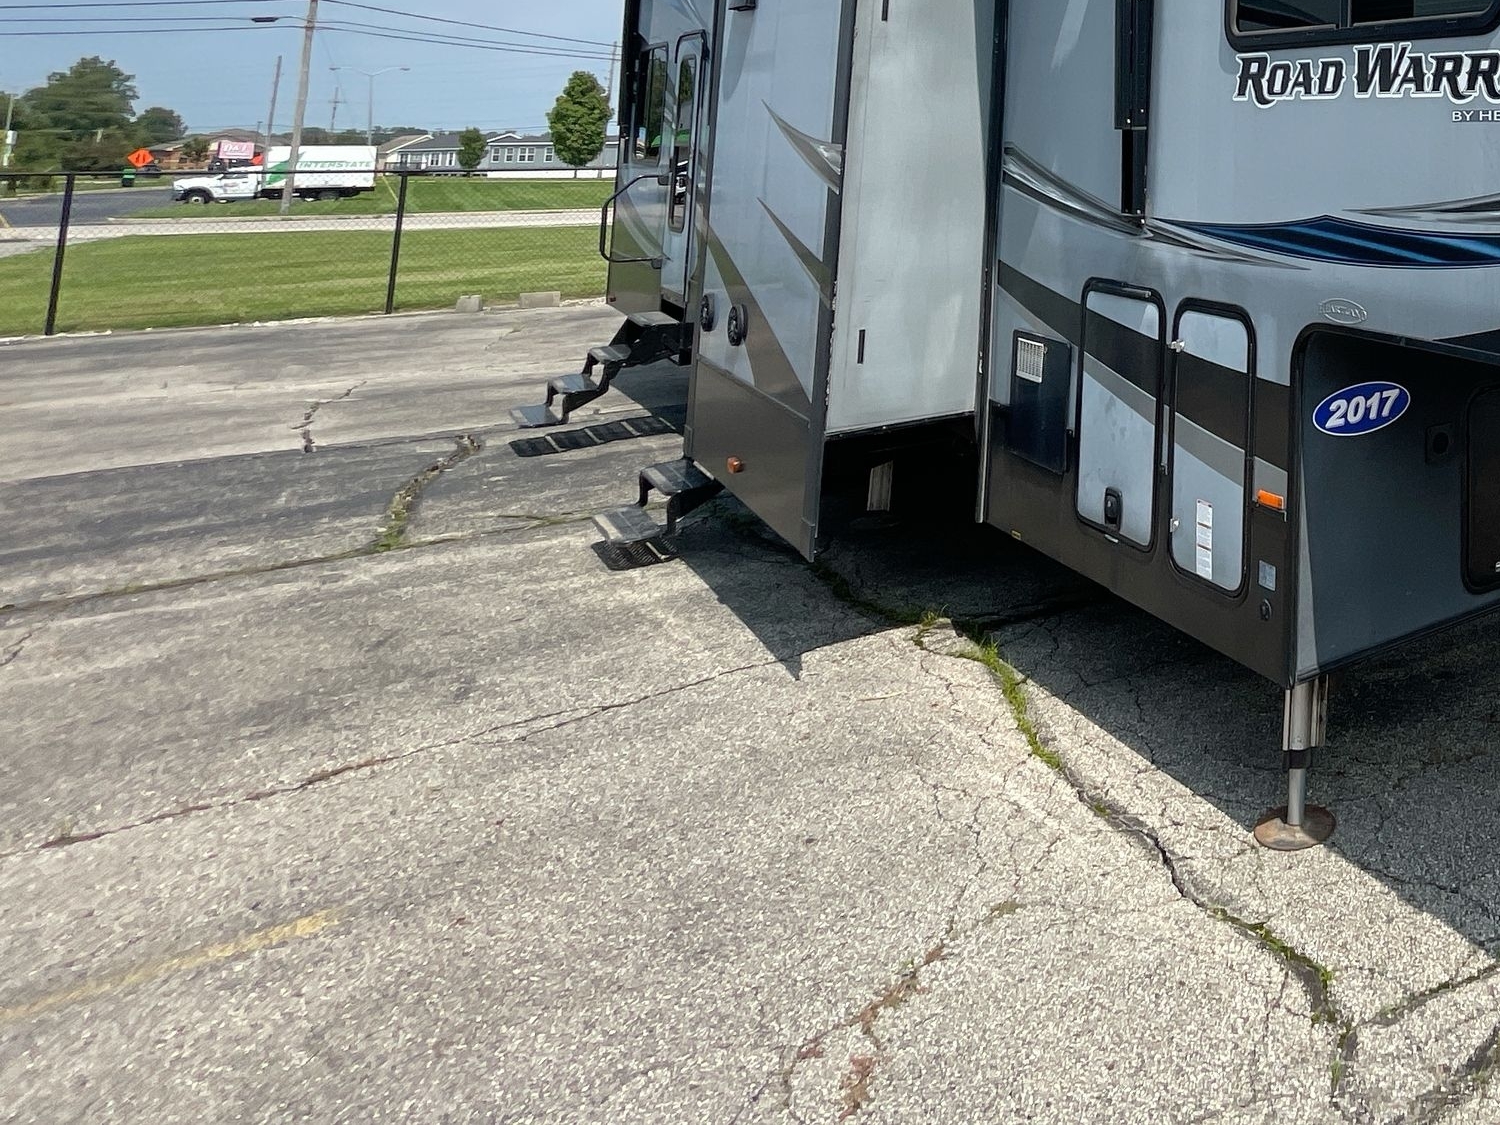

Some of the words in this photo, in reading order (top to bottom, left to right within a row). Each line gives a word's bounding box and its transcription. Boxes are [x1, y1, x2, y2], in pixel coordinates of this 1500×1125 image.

[1232, 51, 1346, 109] ROAD
[1452, 111, 1474, 123] BY
[299, 160, 371, 169] INTERSTATE
[1325, 388, 1400, 429] 2017
